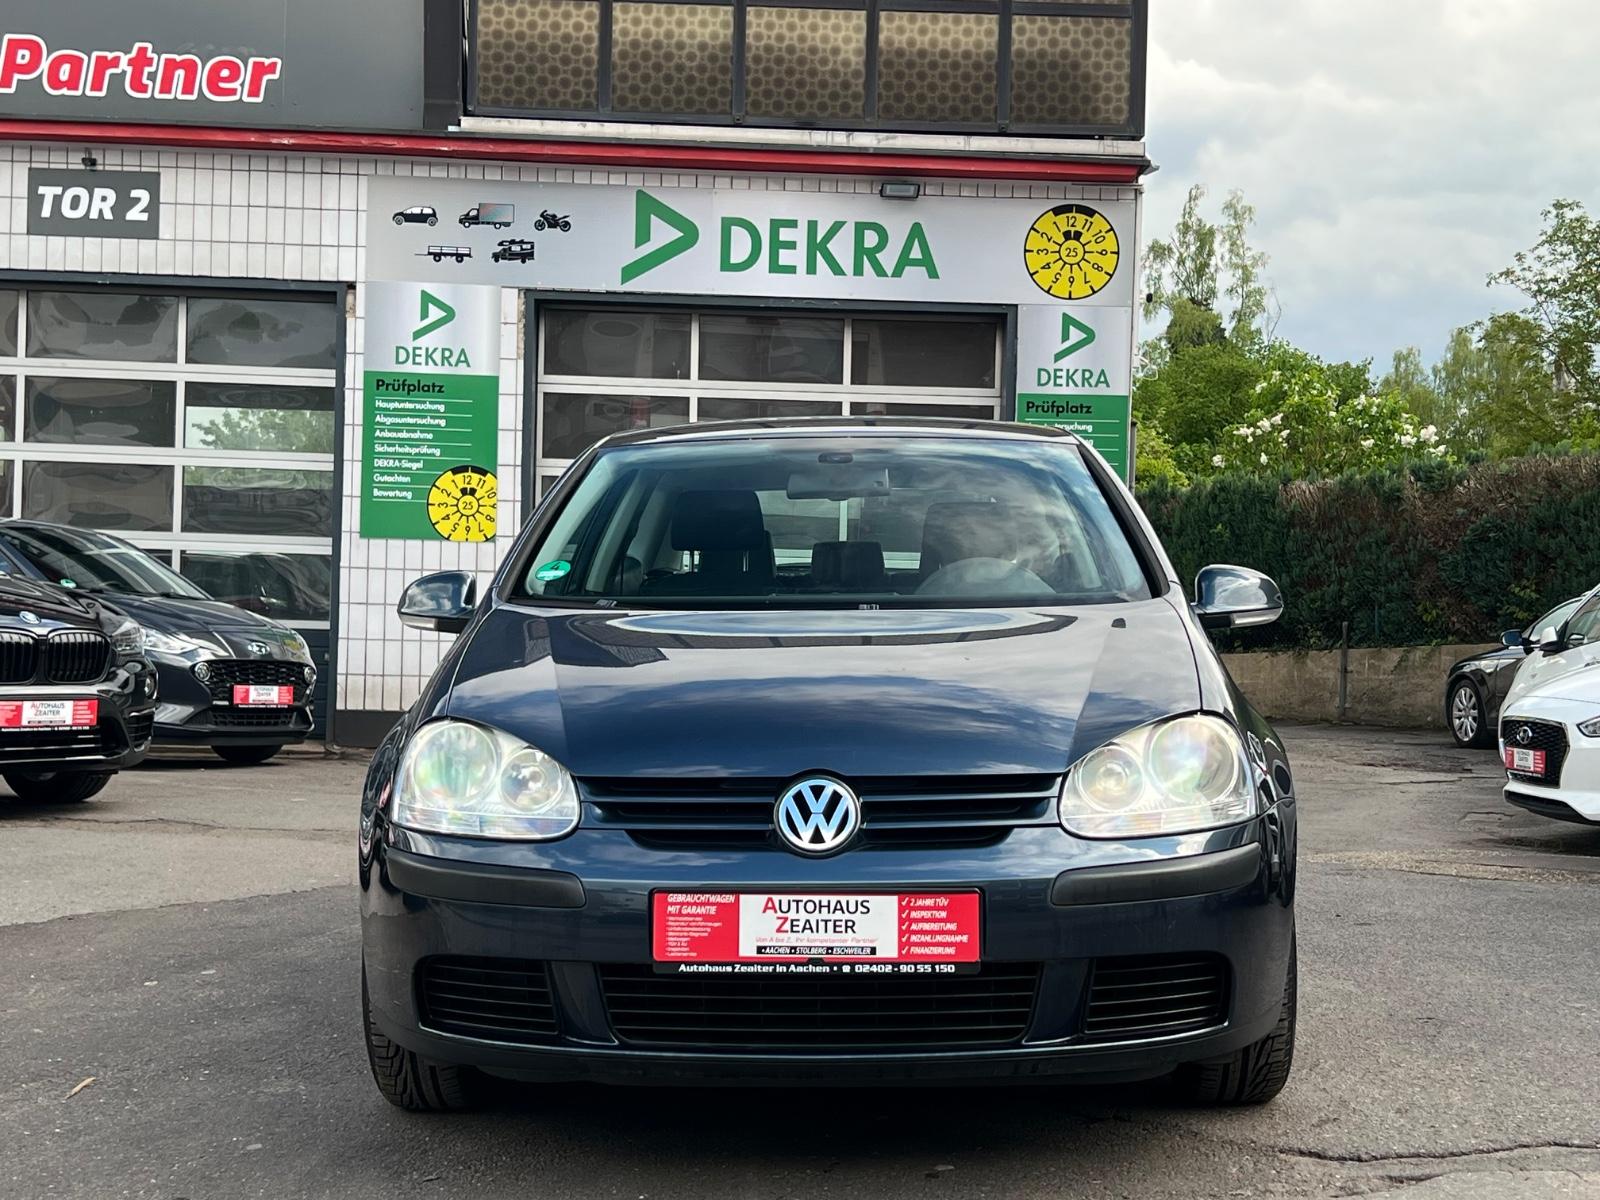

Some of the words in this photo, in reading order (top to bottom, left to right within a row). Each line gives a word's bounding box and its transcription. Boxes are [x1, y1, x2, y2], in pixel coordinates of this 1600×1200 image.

[0, 34, 281, 103] Partner
[37, 185, 117, 220] TOR
[125, 188, 151, 221] 2
[1053, 221, 1061, 232] 1
[1066, 216, 1077, 228] 12
[1082, 218, 1094, 232] 11
[1040, 232, 1052, 242] 2
[1092, 230, 1106, 244] 10
[719, 216, 940, 280] DEKRA
[1065, 248, 1078, 258] 25
[1092, 262, 1104, 272] 8
[1052, 272, 1062, 284] 5
[1068, 276, 1075, 288] 6
[1084, 272, 1090, 284] 7
[395, 346, 471, 368] DEKRA
[1037, 368, 1110, 388] DEKRA
[376, 379, 445, 396] Prüfplatz
[375, 400, 446, 412] Hauptuntersuchung
[1026, 400, 1092, 417] Prüfplatz
[375, 414, 446, 428] Abgasuntersuchung
[374, 429, 434, 440] Anbauabnahme
[374, 444, 440, 456] Sicherheitsprüfung
[374, 459, 424, 470] DEKRA-Siegel
[373, 474, 411, 483] Gutachten
[462, 475, 472, 485] 12
[373, 488, 412, 500] Bewertung
[462, 501, 474, 510] 25
[667, 893, 736, 904] GEBRAUCHTWAGEN
[667, 905, 680, 914] MIT
[681, 906, 718, 915] GARANTIE
[762, 896, 871, 914] AUTOHAUS
[910, 910, 948, 918] INSPEKTION
[776, 916, 857, 934] ZEAITER
[910, 922, 958, 930] AUFBEREITUNG
[910, 946, 956, 954] FINANZIERUNG
[678, 964, 732, 972] Autohaus
[734, 964, 774, 972] Zeaiter
[788, 964, 830, 972] Aachen
[854, 964, 892, 972] 02402
[900, 964, 915, 972] 90
[916, 964, 932, 972] 55
[934, 964, 956, 972] 150
